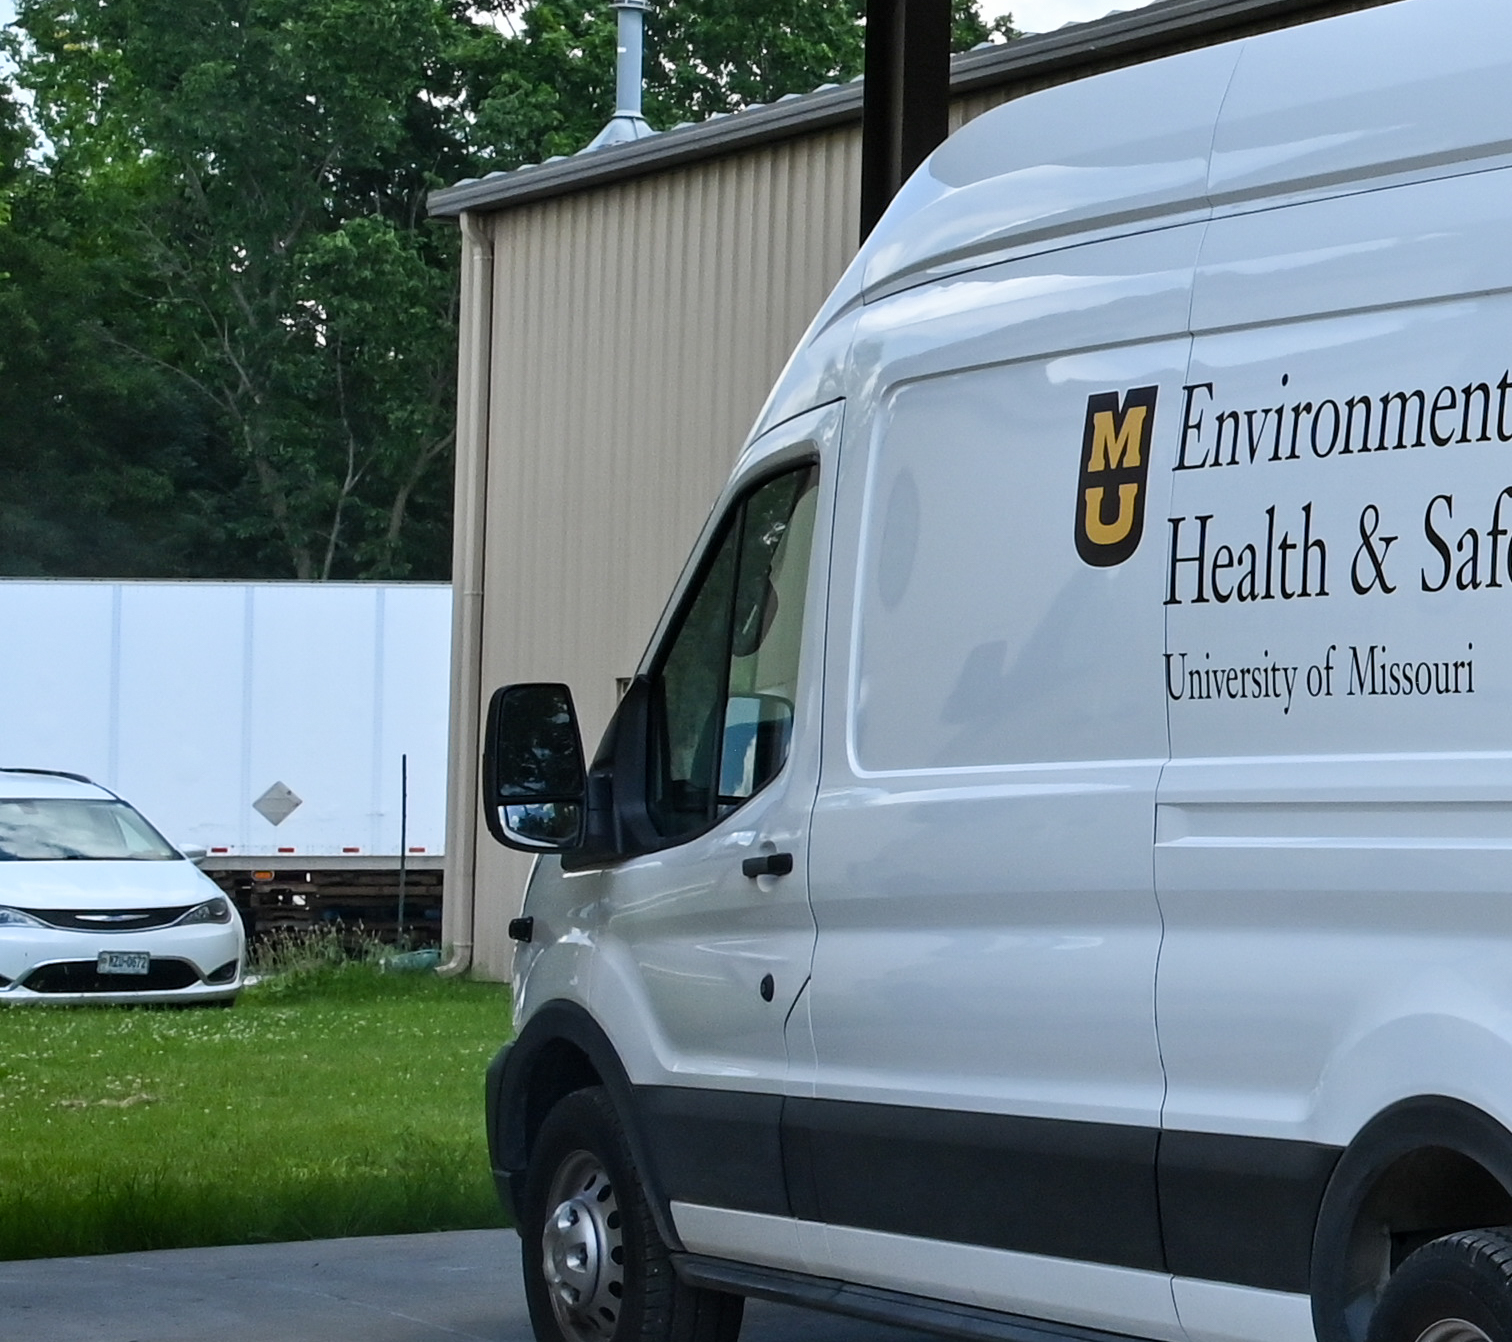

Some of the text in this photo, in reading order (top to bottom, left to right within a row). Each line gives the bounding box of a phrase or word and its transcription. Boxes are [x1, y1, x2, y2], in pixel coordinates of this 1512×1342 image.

[1162, 501, 1330, 606] Health
[1350, 503, 1399, 596] &
[1162, 642, 1476, 715] University of Missouri
